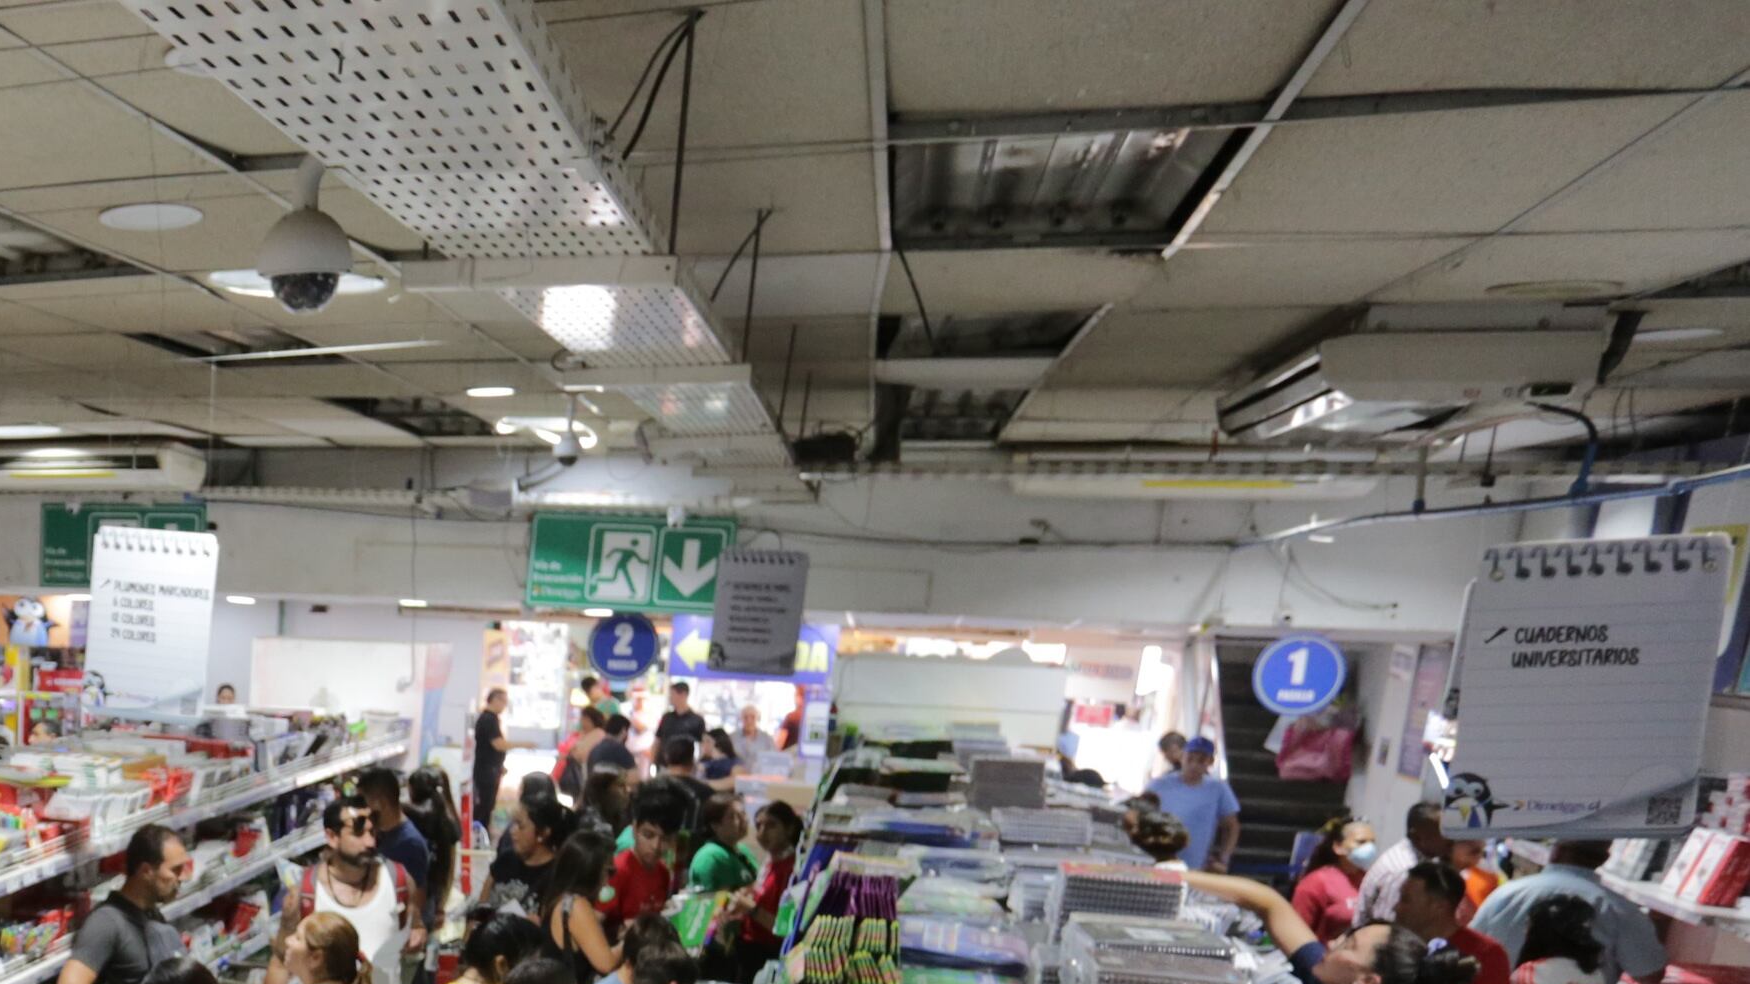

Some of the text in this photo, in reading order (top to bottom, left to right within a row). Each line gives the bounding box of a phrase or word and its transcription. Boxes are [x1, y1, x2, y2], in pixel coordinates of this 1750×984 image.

[613, 622, 635, 656] 2
[1514, 625, 1608, 644] CUADERNOS
[1287, 648, 1309, 686] 1
[1512, 648, 1639, 668] UNIVERSITARIOS
